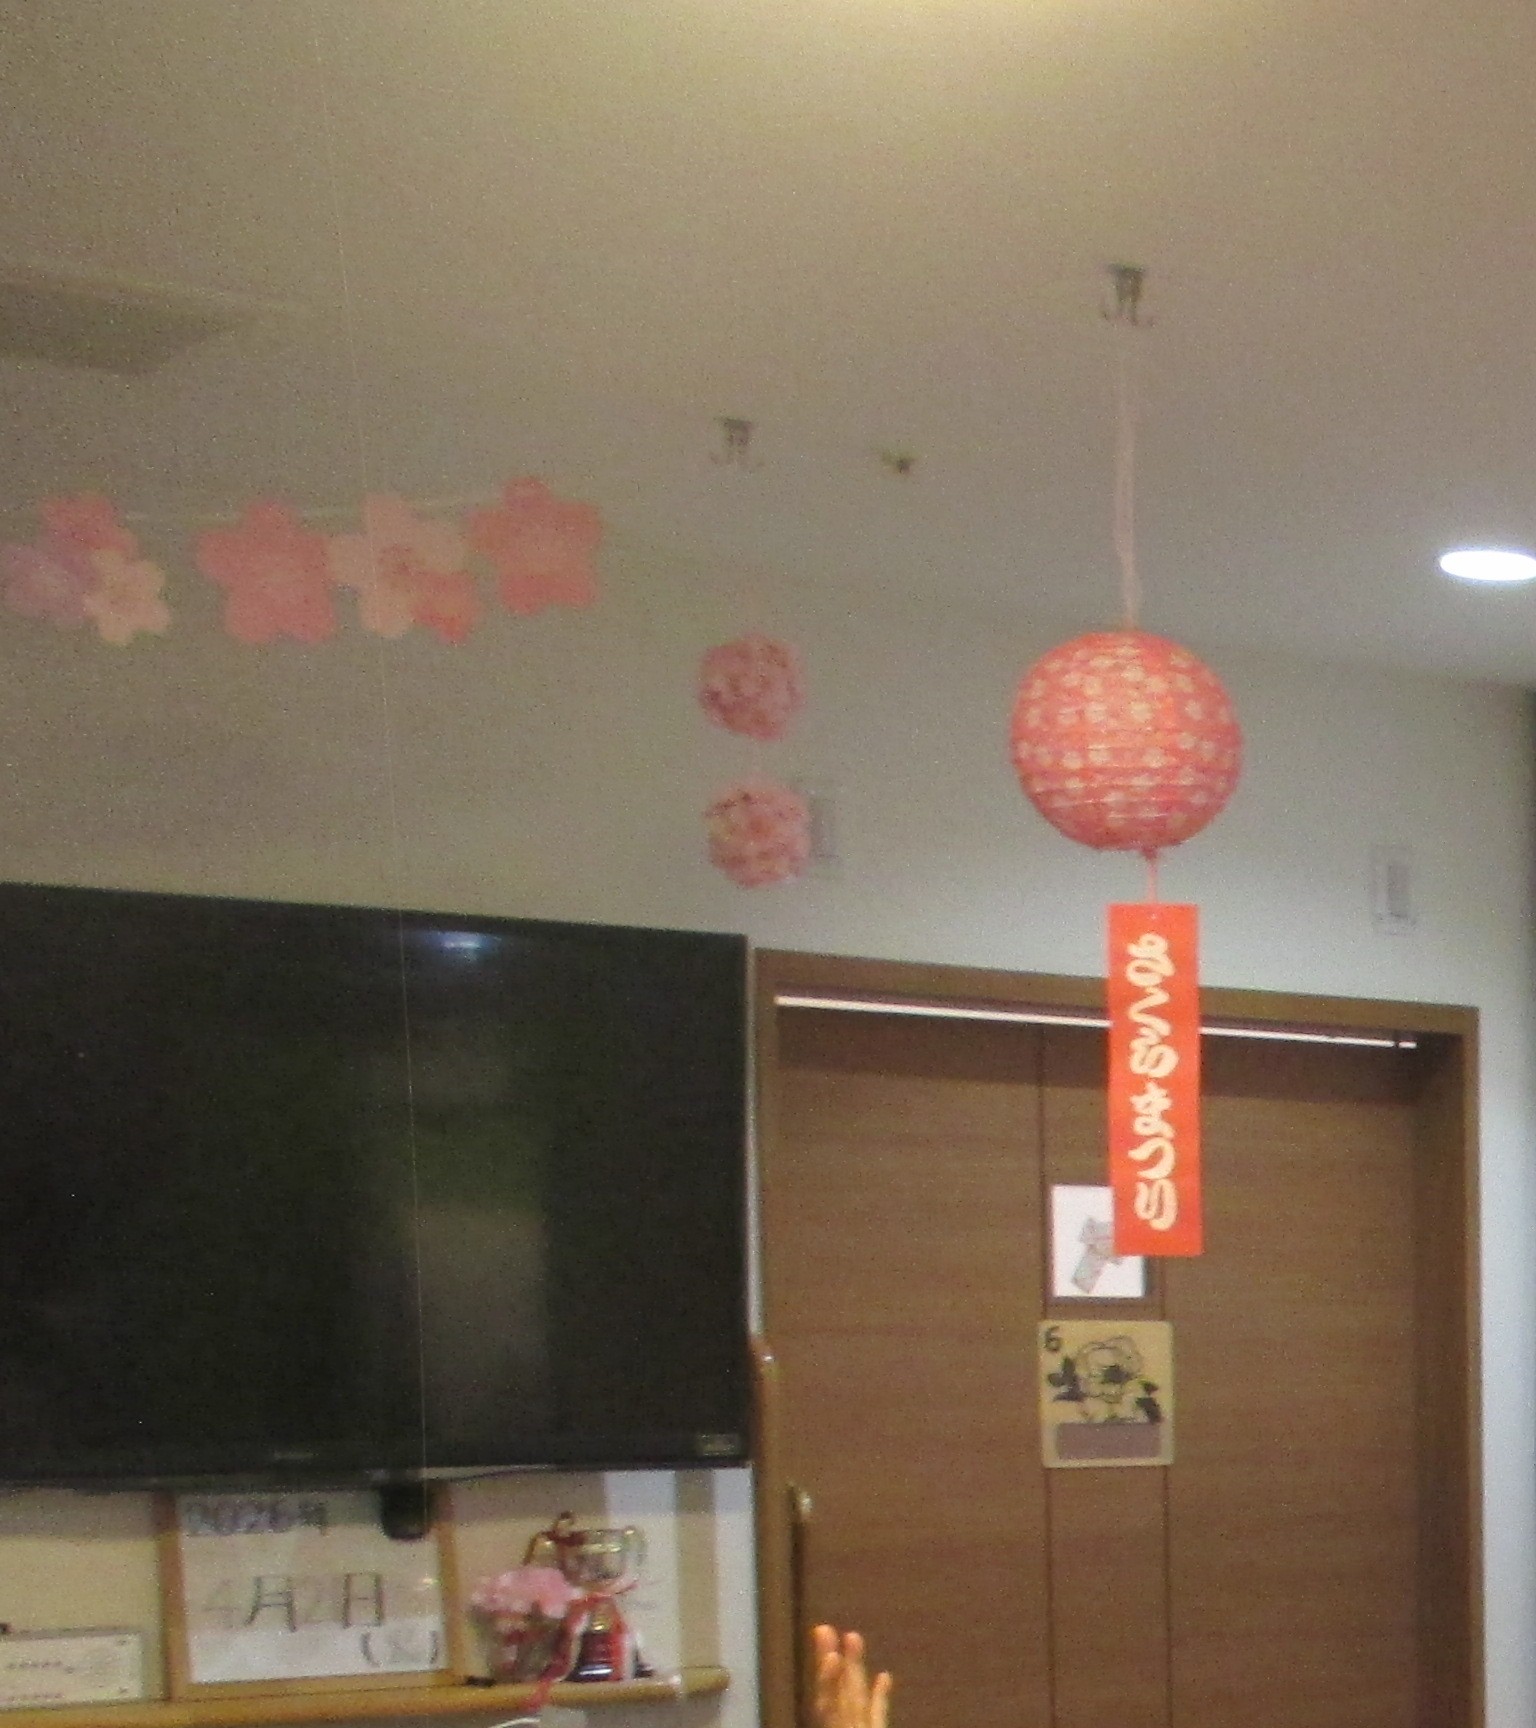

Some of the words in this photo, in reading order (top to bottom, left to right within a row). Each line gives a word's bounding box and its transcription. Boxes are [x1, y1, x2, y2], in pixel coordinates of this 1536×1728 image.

[1126, 932, 1179, 1231] さくらまつり
